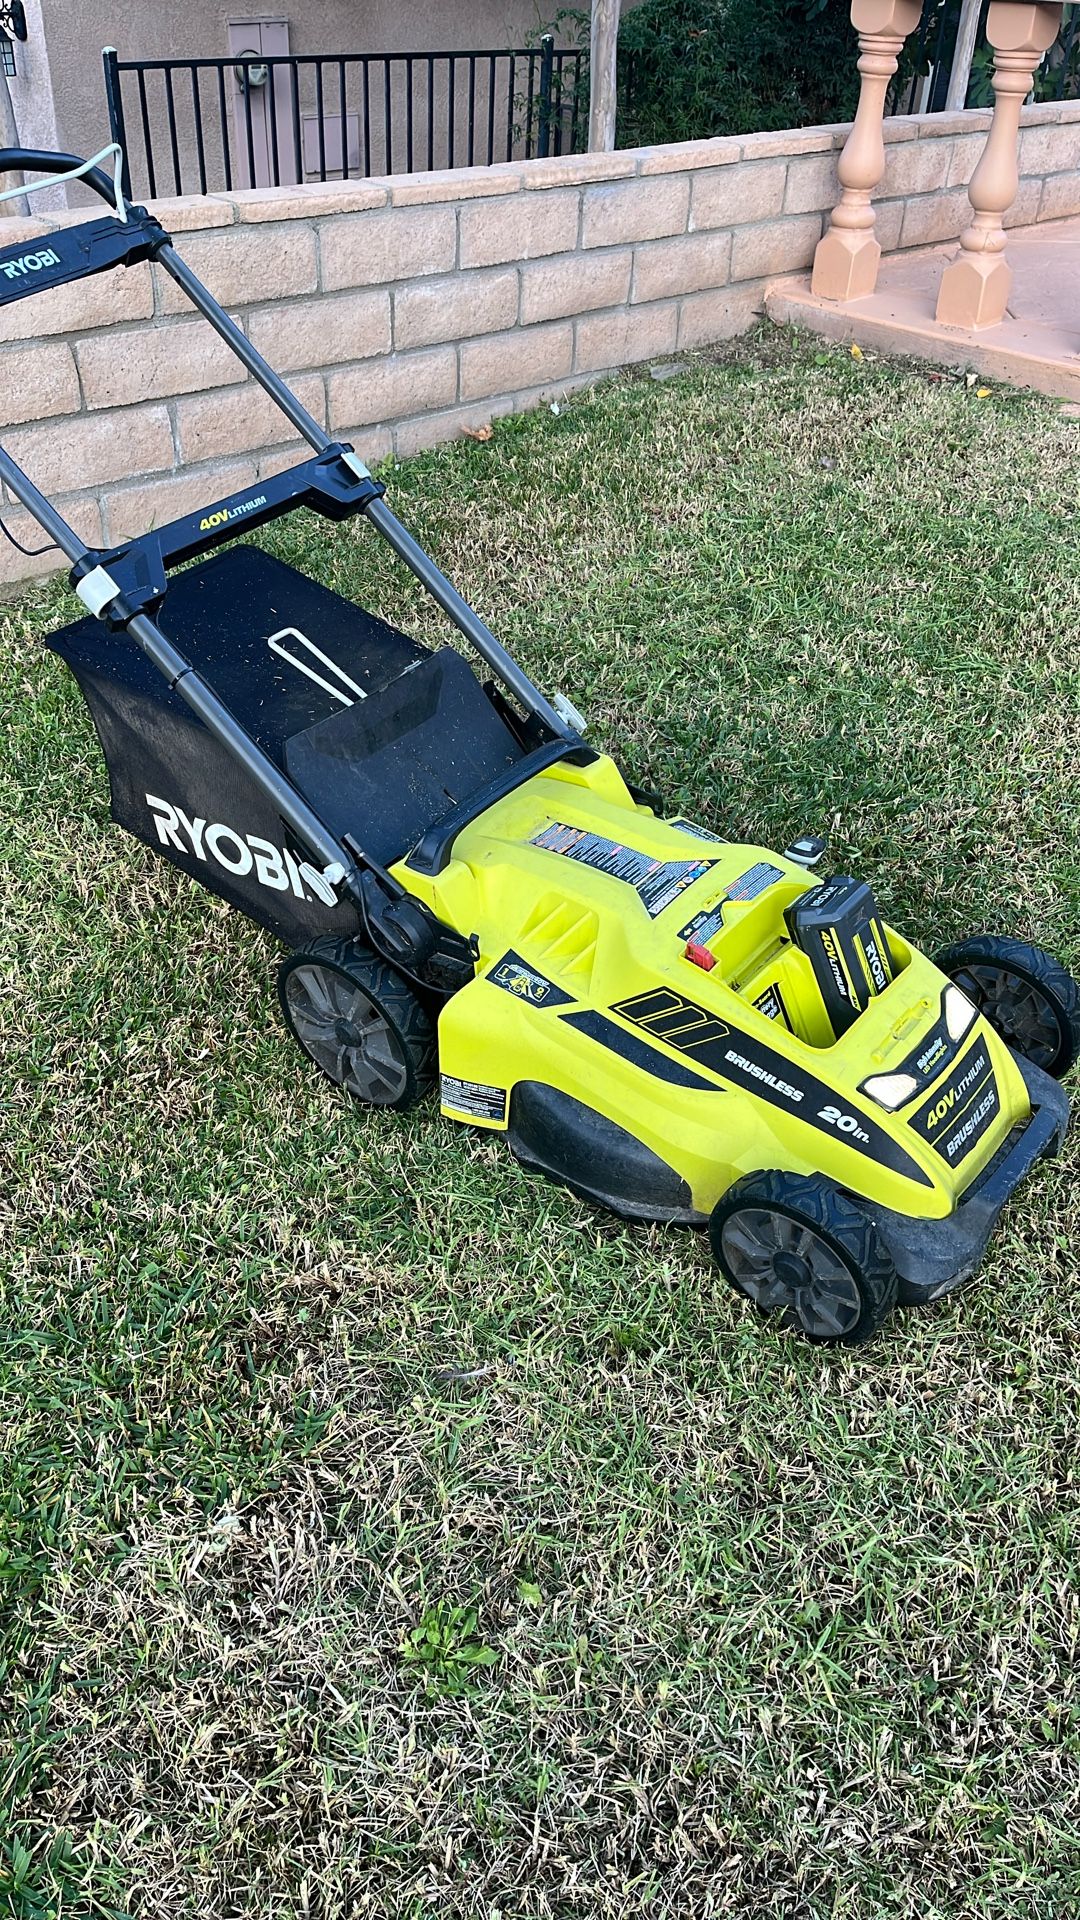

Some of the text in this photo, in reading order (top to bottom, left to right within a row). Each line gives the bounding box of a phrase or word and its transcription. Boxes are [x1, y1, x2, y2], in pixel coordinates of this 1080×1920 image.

[0, 248, 61, 279] RYOBI
[865, 940, 887, 990] RYOBI
[724, 1049, 805, 1102] BRUSHLESS
[946, 1089, 996, 1158] BRUSHLESS
